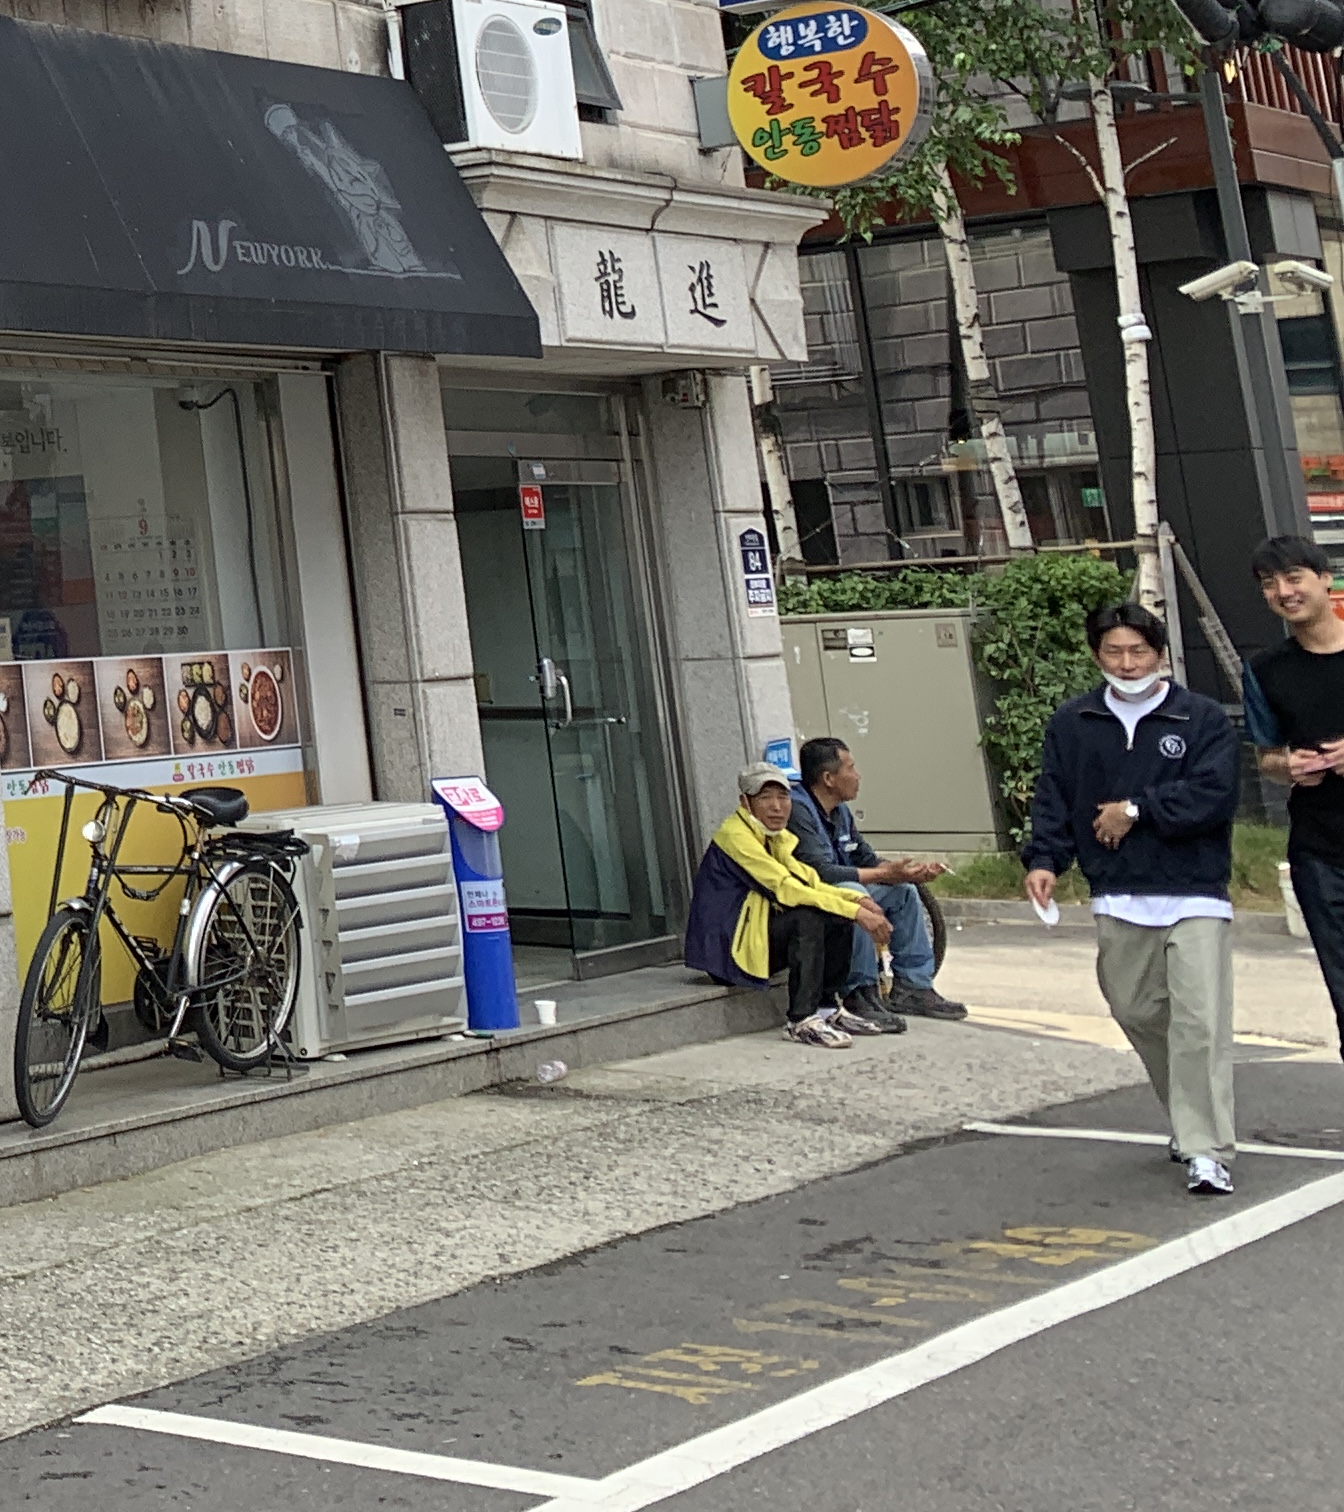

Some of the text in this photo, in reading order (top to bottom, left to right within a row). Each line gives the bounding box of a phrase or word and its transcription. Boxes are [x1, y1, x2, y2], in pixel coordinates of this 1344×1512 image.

[766, 13, 859, 56] 행복한
[740, 51, 900, 116] 칼국수
[752, 100, 901, 161] 안동찜닭
